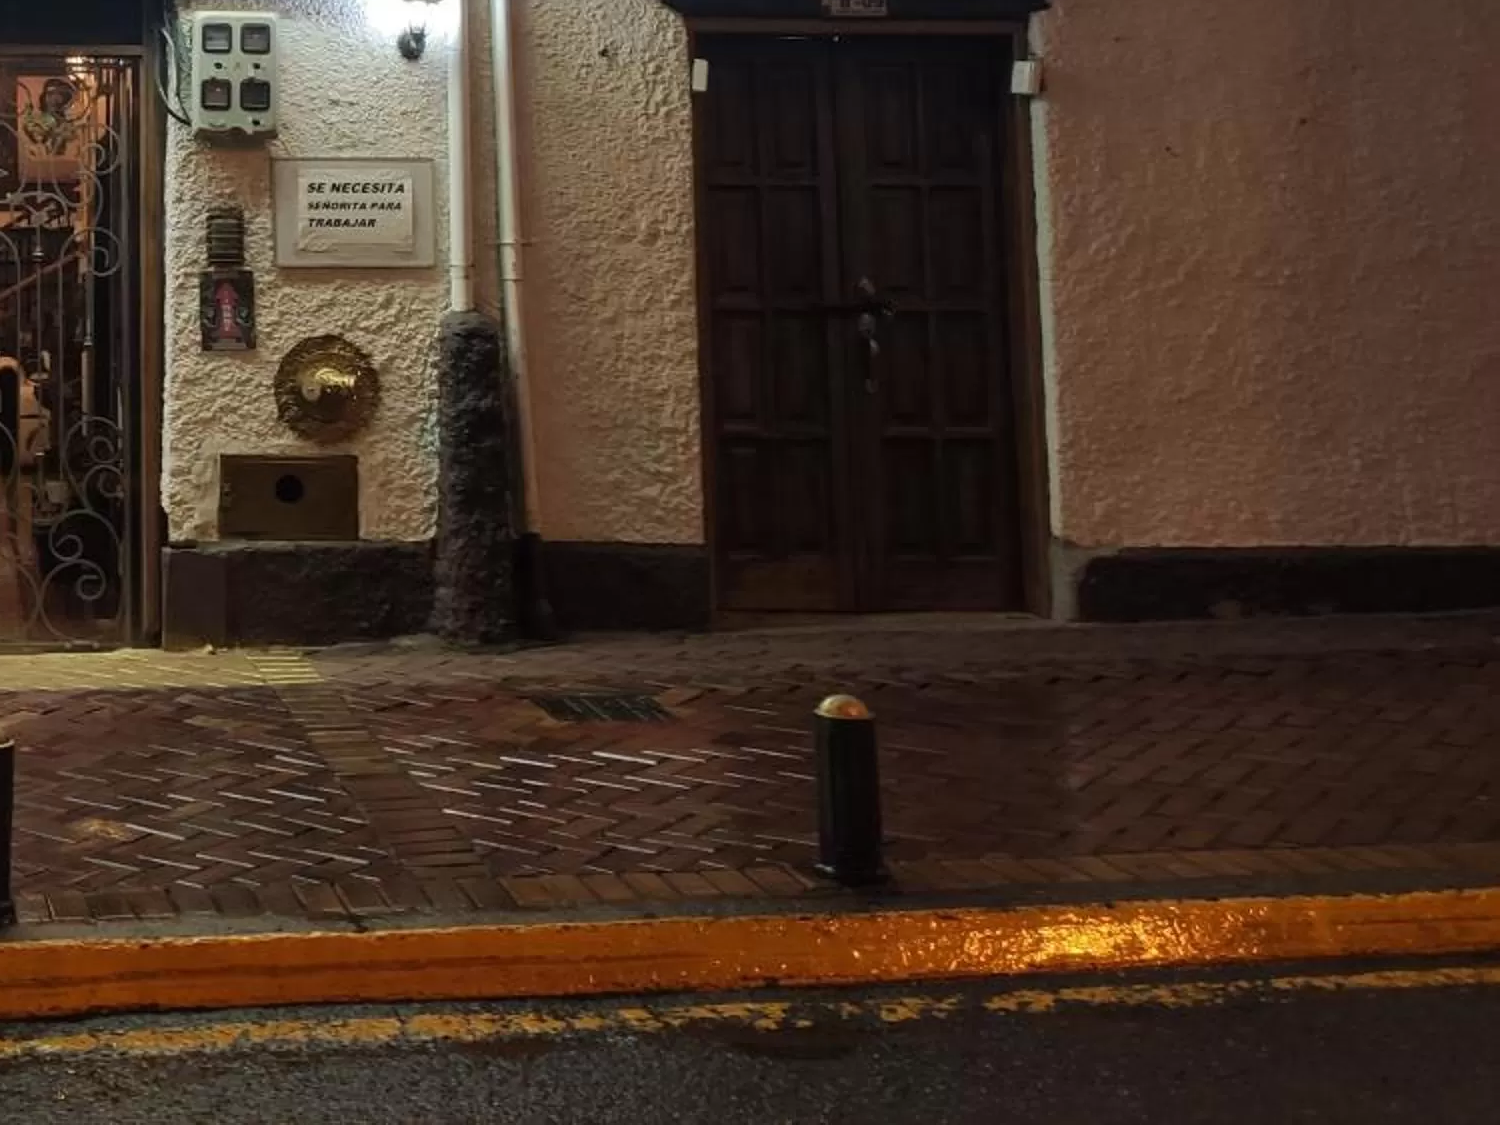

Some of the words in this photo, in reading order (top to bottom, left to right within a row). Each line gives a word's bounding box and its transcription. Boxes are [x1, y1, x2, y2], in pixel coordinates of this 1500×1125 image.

[307, 182, 327, 194] SE
[330, 182, 405, 194] NECESITA
[369, 201, 402, 211] PARA
[307, 218, 377, 228] TRABAJAR
